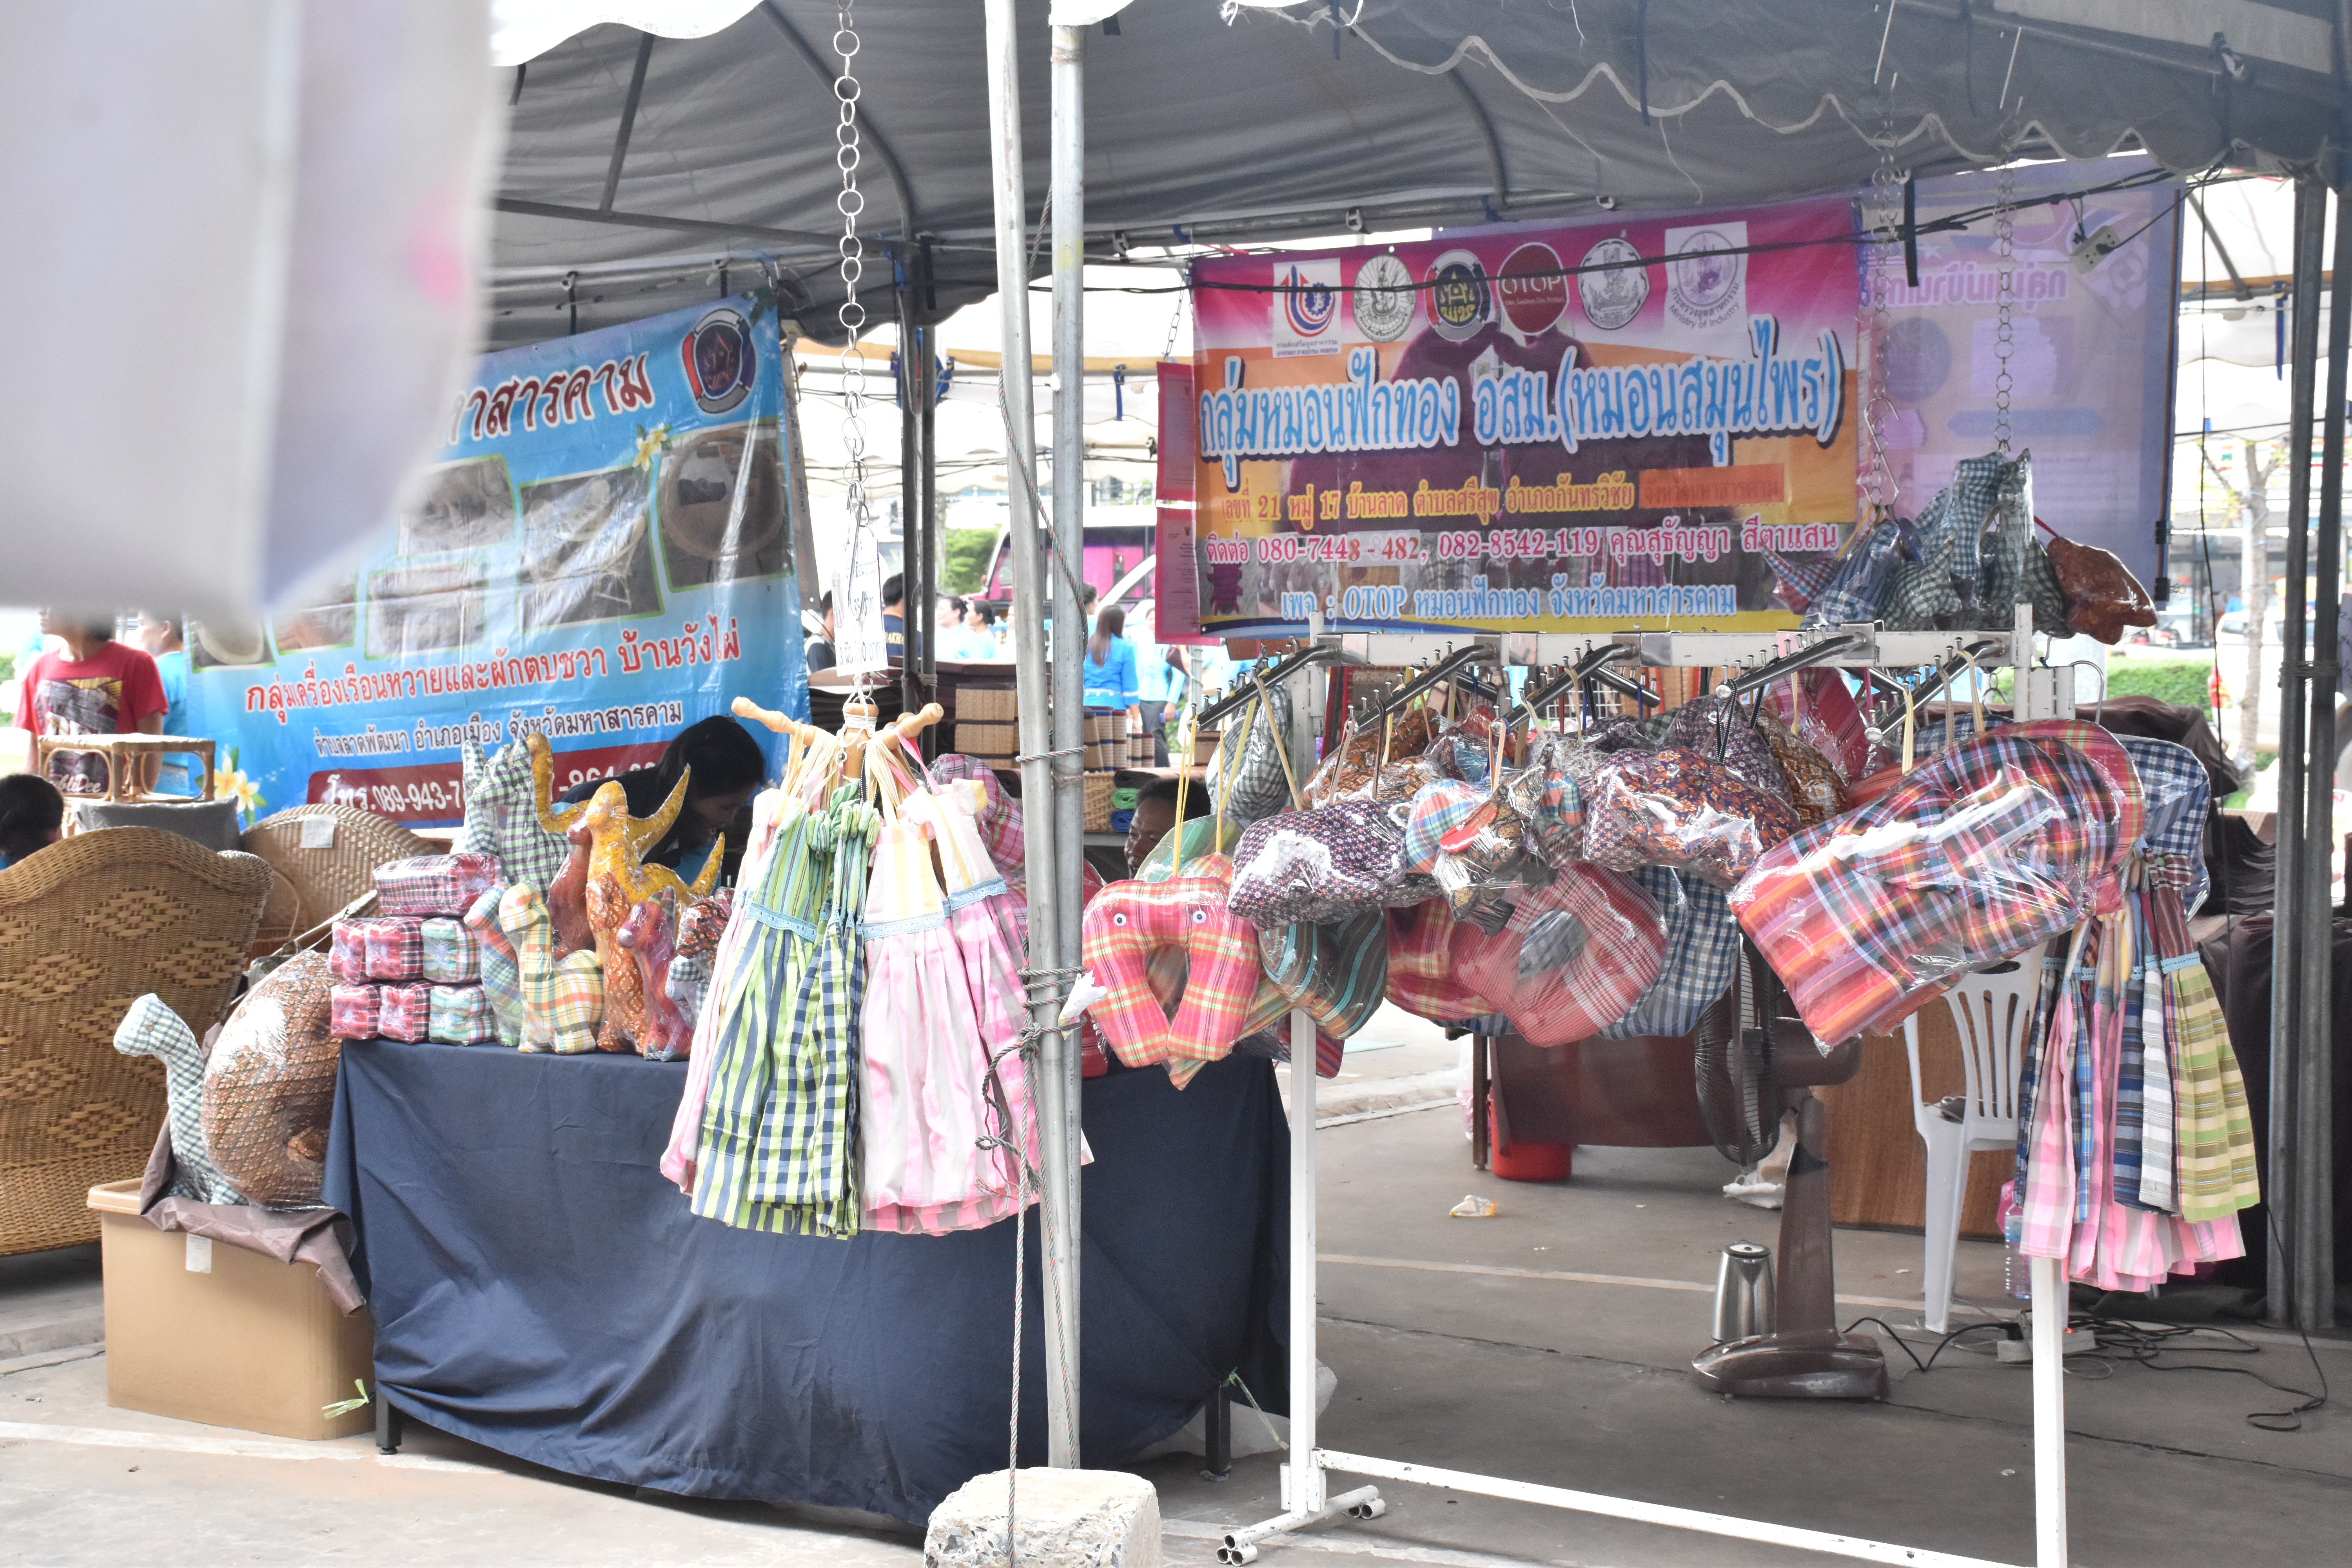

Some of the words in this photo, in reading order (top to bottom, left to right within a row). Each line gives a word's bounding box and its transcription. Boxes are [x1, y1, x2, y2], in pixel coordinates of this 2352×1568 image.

[1669, 305, 1697, 329] Ministry
[1698, 319, 1707, 328] of
[1709, 301, 1739, 327] Industry
[1200, 349, 1459, 484] กลุ่มหมอนฟักทอง
[1222, 478, 1250, 519] เลขที่
[1258, 495, 1280, 518] 21
[1289, 485, 1314, 529] หมู่
[1321, 490, 1341, 519] 17
[1347, 482, 1408, 517] บ้านลาด
[1414, 476, 1499, 524] ตำบลศรีสุข
[1506, 471, 1635, 514] อำเภอกันทรวิชัย
[1206, 530, 1249, 563] ติดต่อ
[1439, 529, 1599, 560] 082-8542-119
[1610, 516, 1731, 566] คุณสุธัญญา
[1741, 513, 1838, 553] สีตาแสน
[1281, 591, 1318, 620] เพจ
[1343, 585, 1408, 620] OTOP
[1414, 574, 1540, 620] หมอนฟักทอง
[1548, 572, 1737, 618] จังหวัดมหาสารคาม
[618, 613, 741, 673] บ้านวังไผ่
[414, 713, 501, 749] อำเภอเมือง
[509, 701, 683, 739] จังหวัดมหาสารคาม
